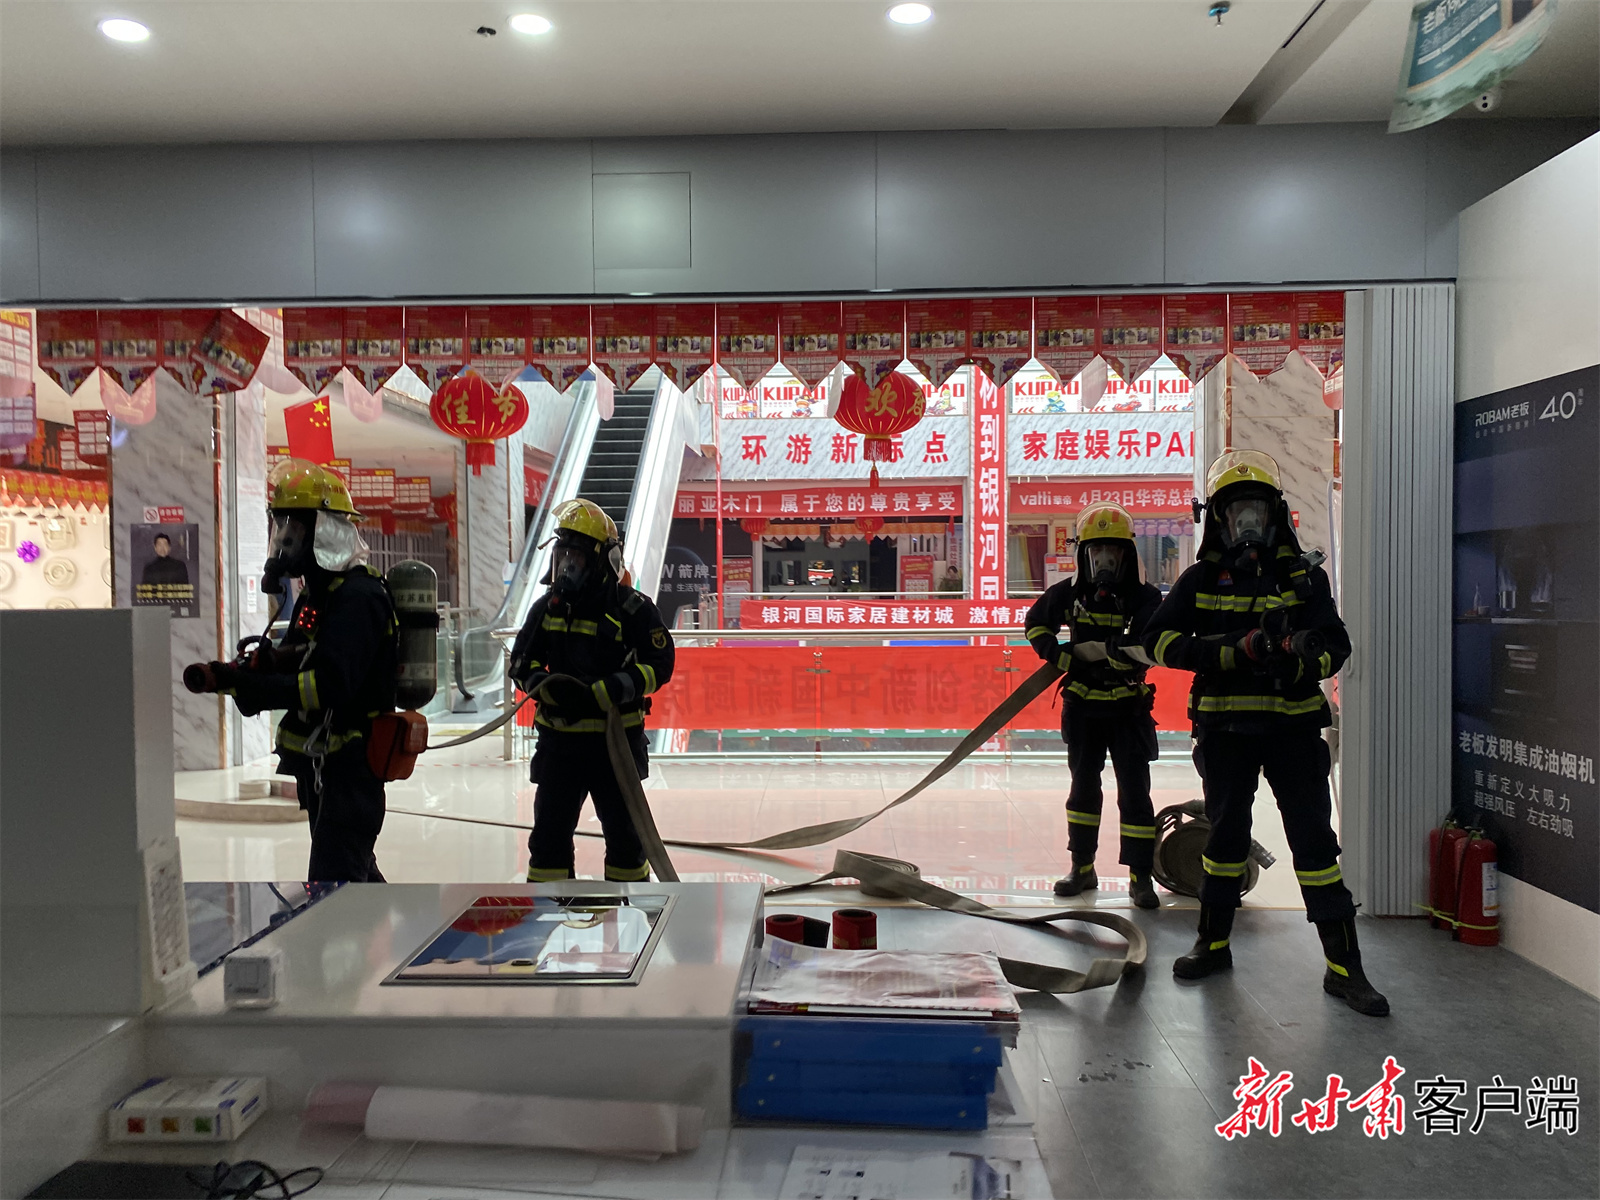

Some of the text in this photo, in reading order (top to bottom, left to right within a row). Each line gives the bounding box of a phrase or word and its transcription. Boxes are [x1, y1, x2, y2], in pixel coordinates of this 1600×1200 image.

[763, 386, 826, 401] KUPAO
[1014, 381, 1080, 397] KUPAO
[678, 491, 956, 514] 丽亚木门 属于您的尊贵享受
[761, 605, 955, 625] 银河国际家居建材城
[1458, 730, 1596, 785] 老板发明集成油烟机
[1473, 769, 1572, 813] 重新定义大吸力
[1526, 806, 1575, 839] 左右劲吸
